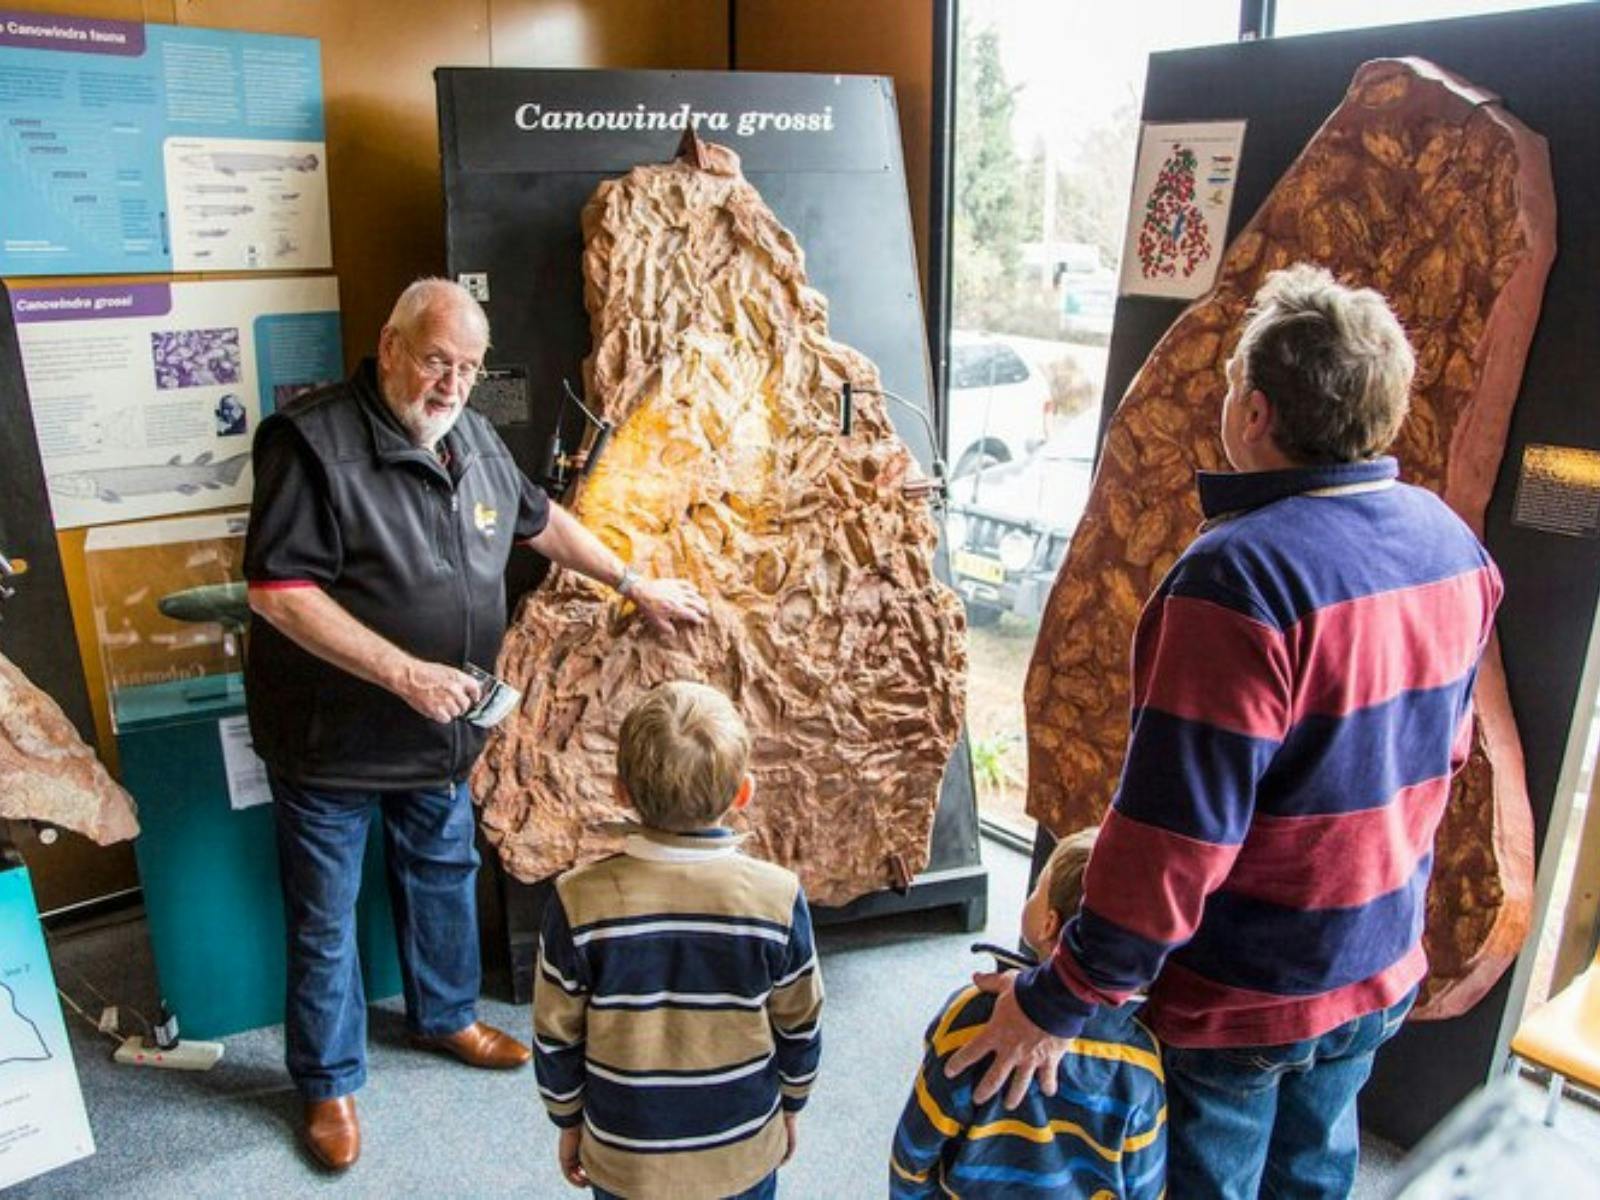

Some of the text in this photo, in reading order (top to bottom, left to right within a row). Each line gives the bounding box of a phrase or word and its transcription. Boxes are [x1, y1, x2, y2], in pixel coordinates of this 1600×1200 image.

[7, 21, 88, 40] Canowindra
[89, 28, 126, 44] fauna
[514, 102, 834, 136] Canowindra grossi
[16, 295, 133, 312] Canowindra grossi
